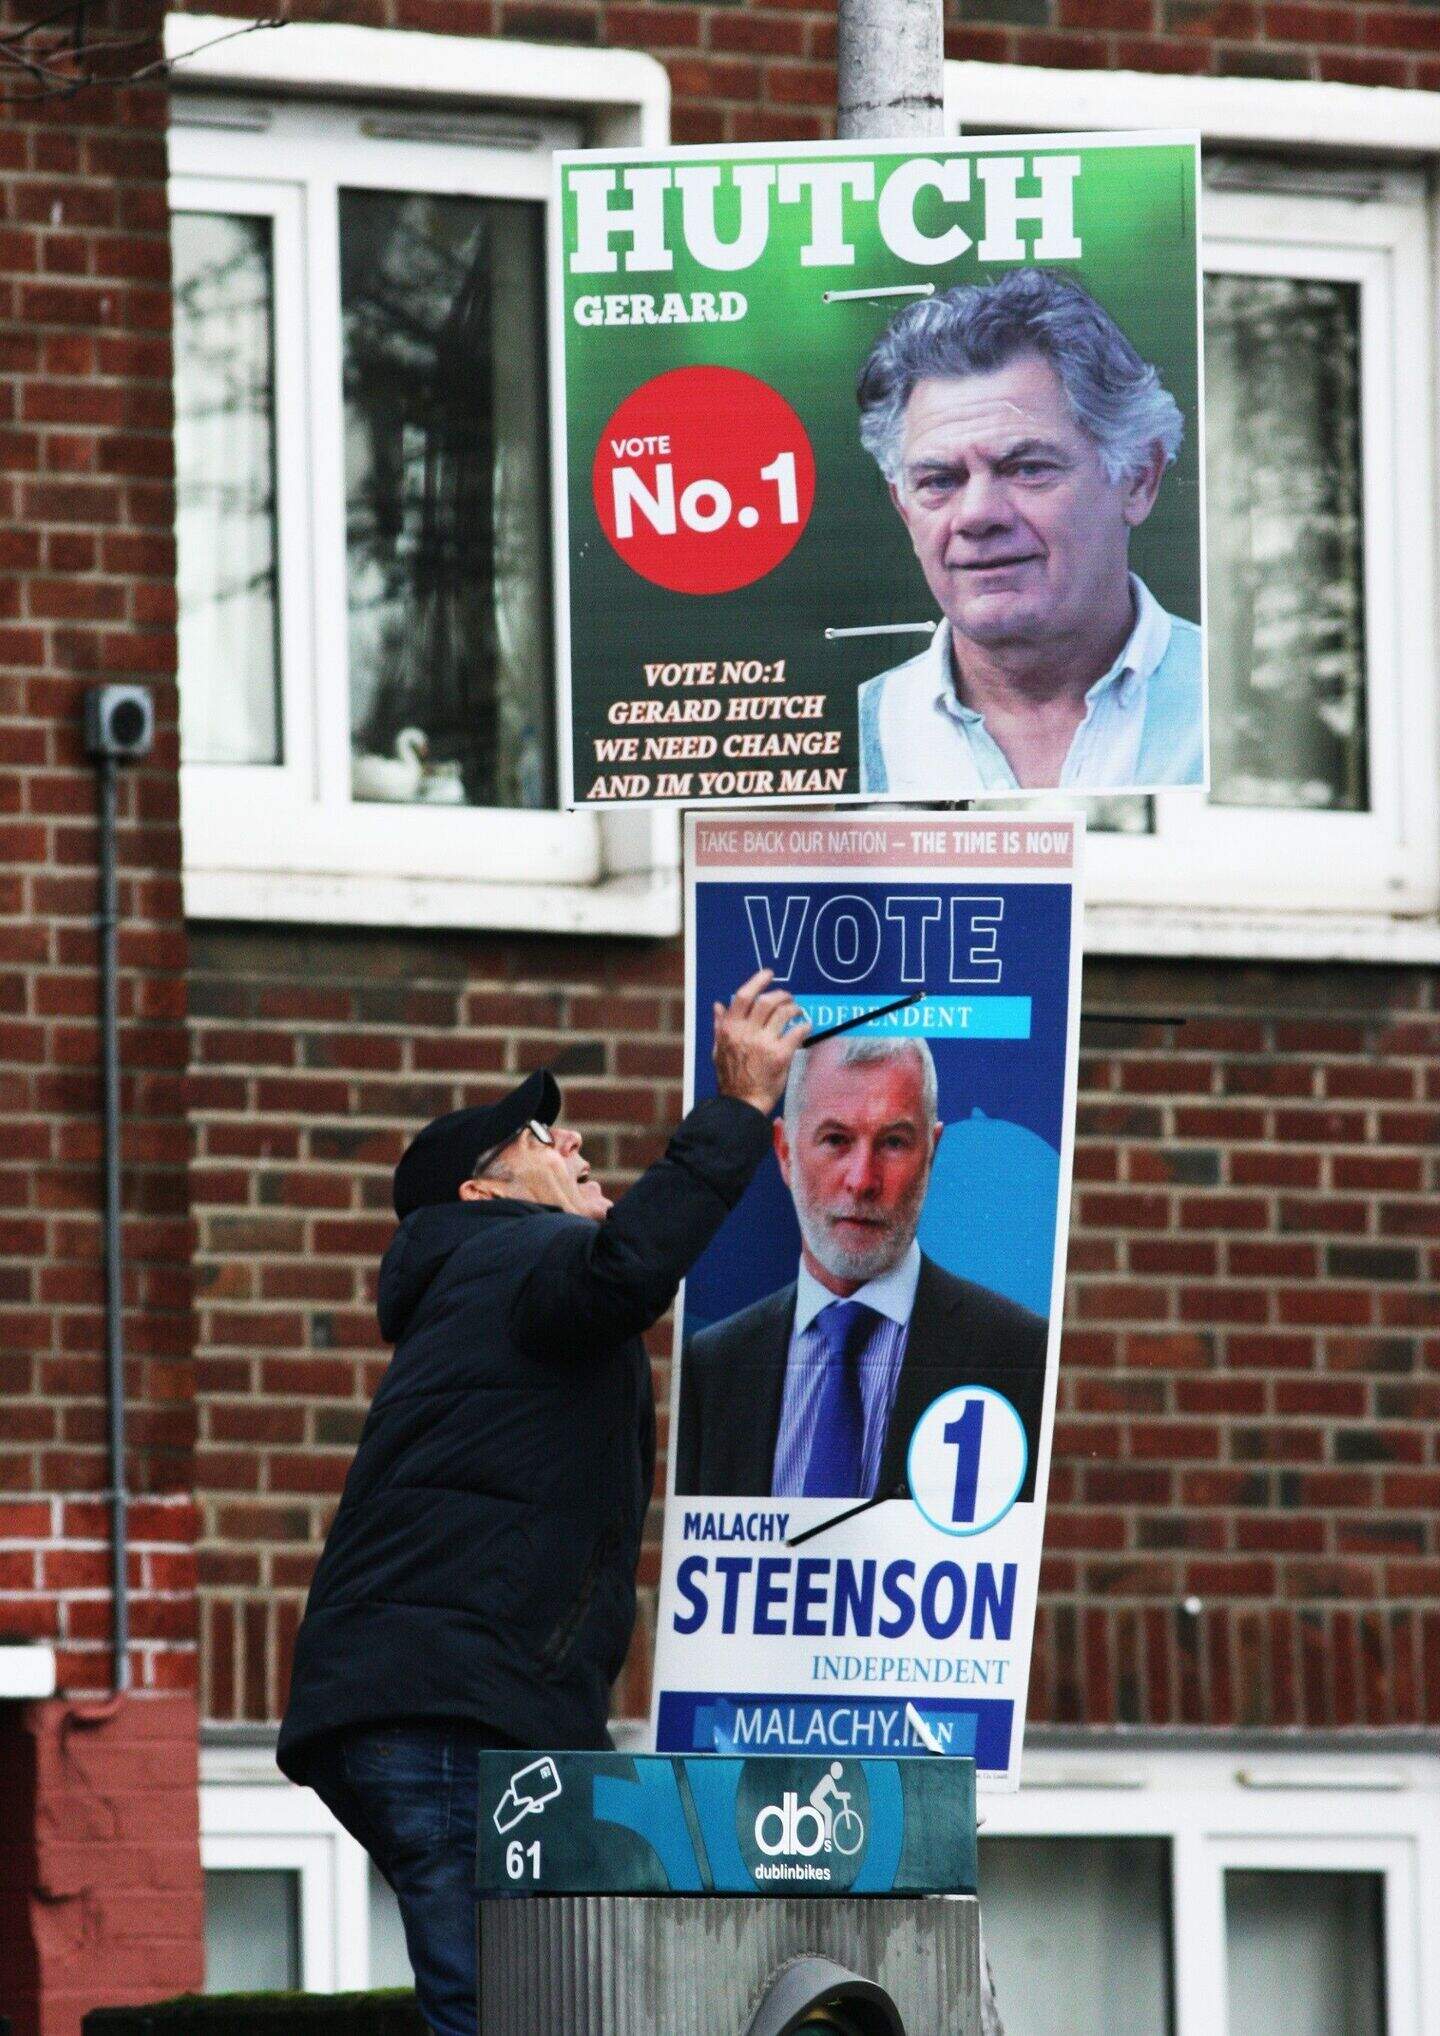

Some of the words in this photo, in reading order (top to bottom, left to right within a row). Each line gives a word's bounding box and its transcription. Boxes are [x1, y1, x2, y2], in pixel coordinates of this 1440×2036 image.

[568, 155, 1083, 273] HUTCH
[573, 291, 748, 326] GERARD
[611, 434, 671, 457] VOTE
[611, 452, 800, 539] No.1
[644, 661, 716, 687] VOTE
[720, 660, 787, 684] NO:1
[608, 699, 722, 724] GERARD
[726, 695, 826, 721] HUTCH
[594, 738, 640, 762] WE
[643, 734, 718, 761] NEED
[722, 731, 842, 758] CHANGE
[587, 774, 650, 799] AND
[654, 773, 693, 797] IM
[698, 771, 774, 795] YOUR
[778, 768, 848, 793] MAN
[701, 831, 738, 853] TAKE
[743, 831, 785, 852] BACK
[789, 831, 823, 852] OUR
[828, 831, 887, 853] NATION
[911, 831, 947, 853] THE
[953, 831, 998, 853] TIME
[1003, 832, 1021, 853] IS
[1026, 832, 1070, 854] NOW
[744, 894, 1004, 984] VOTE
[943, 1399, 985, 1523] 1
[683, 1512, 789, 1542] MALACHY
[673, 1555, 1018, 1641] STEENSON
[812, 1656, 1010, 1685] INDEPENDENT
[506, 1841, 542, 1880] 61
[755, 1864, 832, 1881] dublinbikes
